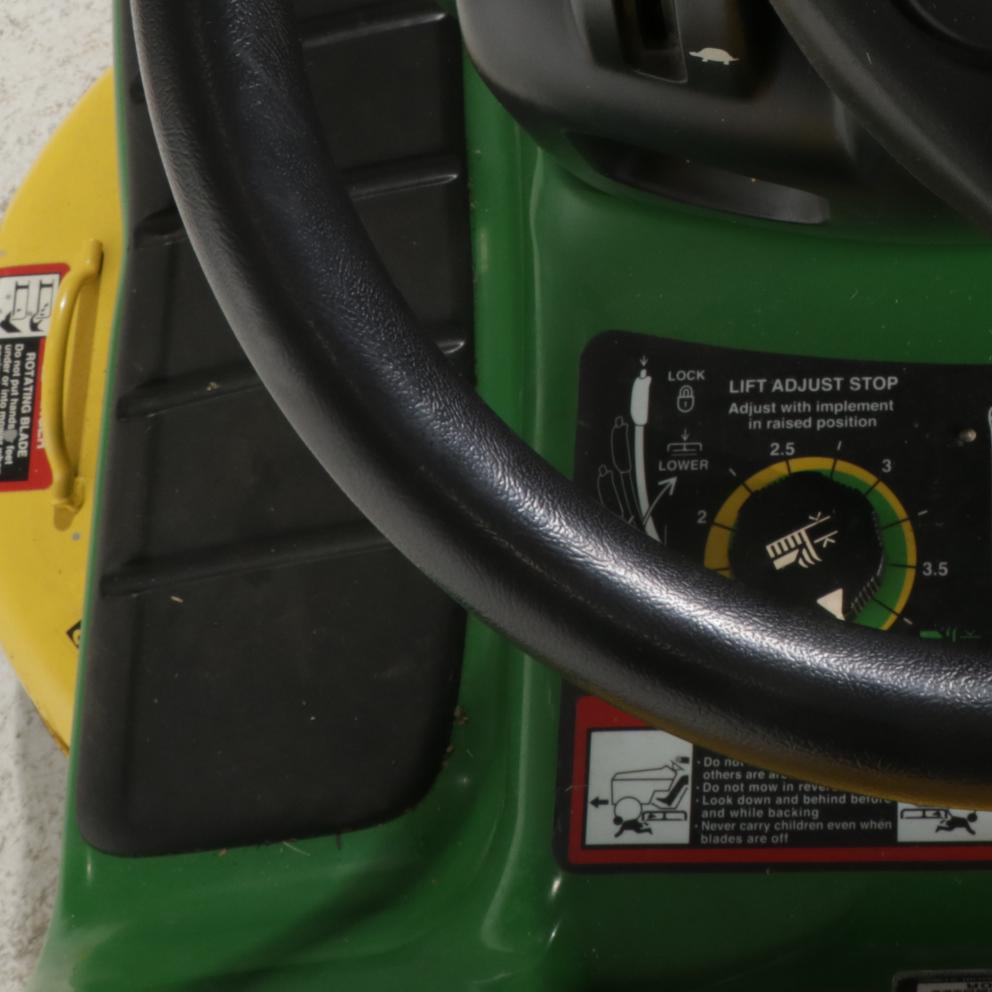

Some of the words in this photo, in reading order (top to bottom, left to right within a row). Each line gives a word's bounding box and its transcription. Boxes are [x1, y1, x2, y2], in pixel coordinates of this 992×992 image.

[14, 343, 24, 358] Do
[2, 344, 13, 374] under
[12, 359, 21, 377] not
[668, 369, 706, 382] LOCK
[1, 376, 10, 387] or
[10, 379, 20, 396] put
[20, 351, 37, 415] ROTATING
[729, 379, 767, 394] LIFT
[771, 377, 844, 393] ADJUST
[849, 376, 899, 391] STOP
[0, 389, 10, 409] into
[7, 397, 19, 430] hands
[728, 402, 776, 417] Adjust
[780, 400, 811, 413] with
[816, 399, 895, 415] implement
[748, 418, 762, 430] in
[766, 416, 812, 429] raised
[816, 416, 877, 431] position
[16, 416, 31, 459] BLADE
[4, 445, 15, 465] feet
[769, 442, 796, 456] 2.5
[658, 458, 710, 472] LOWER
[881, 459, 893, 473] 3
[697, 509, 707, 524] 2
[922, 562, 949, 577] 3.5
[703, 756, 721, 768] Do
[703, 769, 742, 780] others
[746, 771, 765, 780] are
[702, 782, 720, 793] Do
[724, 782, 744, 793] not
[749, 783, 779, 792] mow
[782, 782, 794, 792] in
[799, 783, 837, 792] reve
[702, 795, 733, 806] Look
[737, 795, 771, 805] down
[775, 794, 799, 804] and
[803, 794, 846, 804] behind
[701, 808, 725, 818] and
[730, 807, 764, 818] while
[767, 807, 820, 820] backing
[701, 821, 736, 831] Never
[739, 822, 770, 833] carry
[774, 819, 824, 831] children
[827, 821, 856, 831] even
[860, 819, 892, 830] when
[700, 834, 743, 844] blades
[747, 835, 767, 844] are
[771, 833, 789, 844] off
